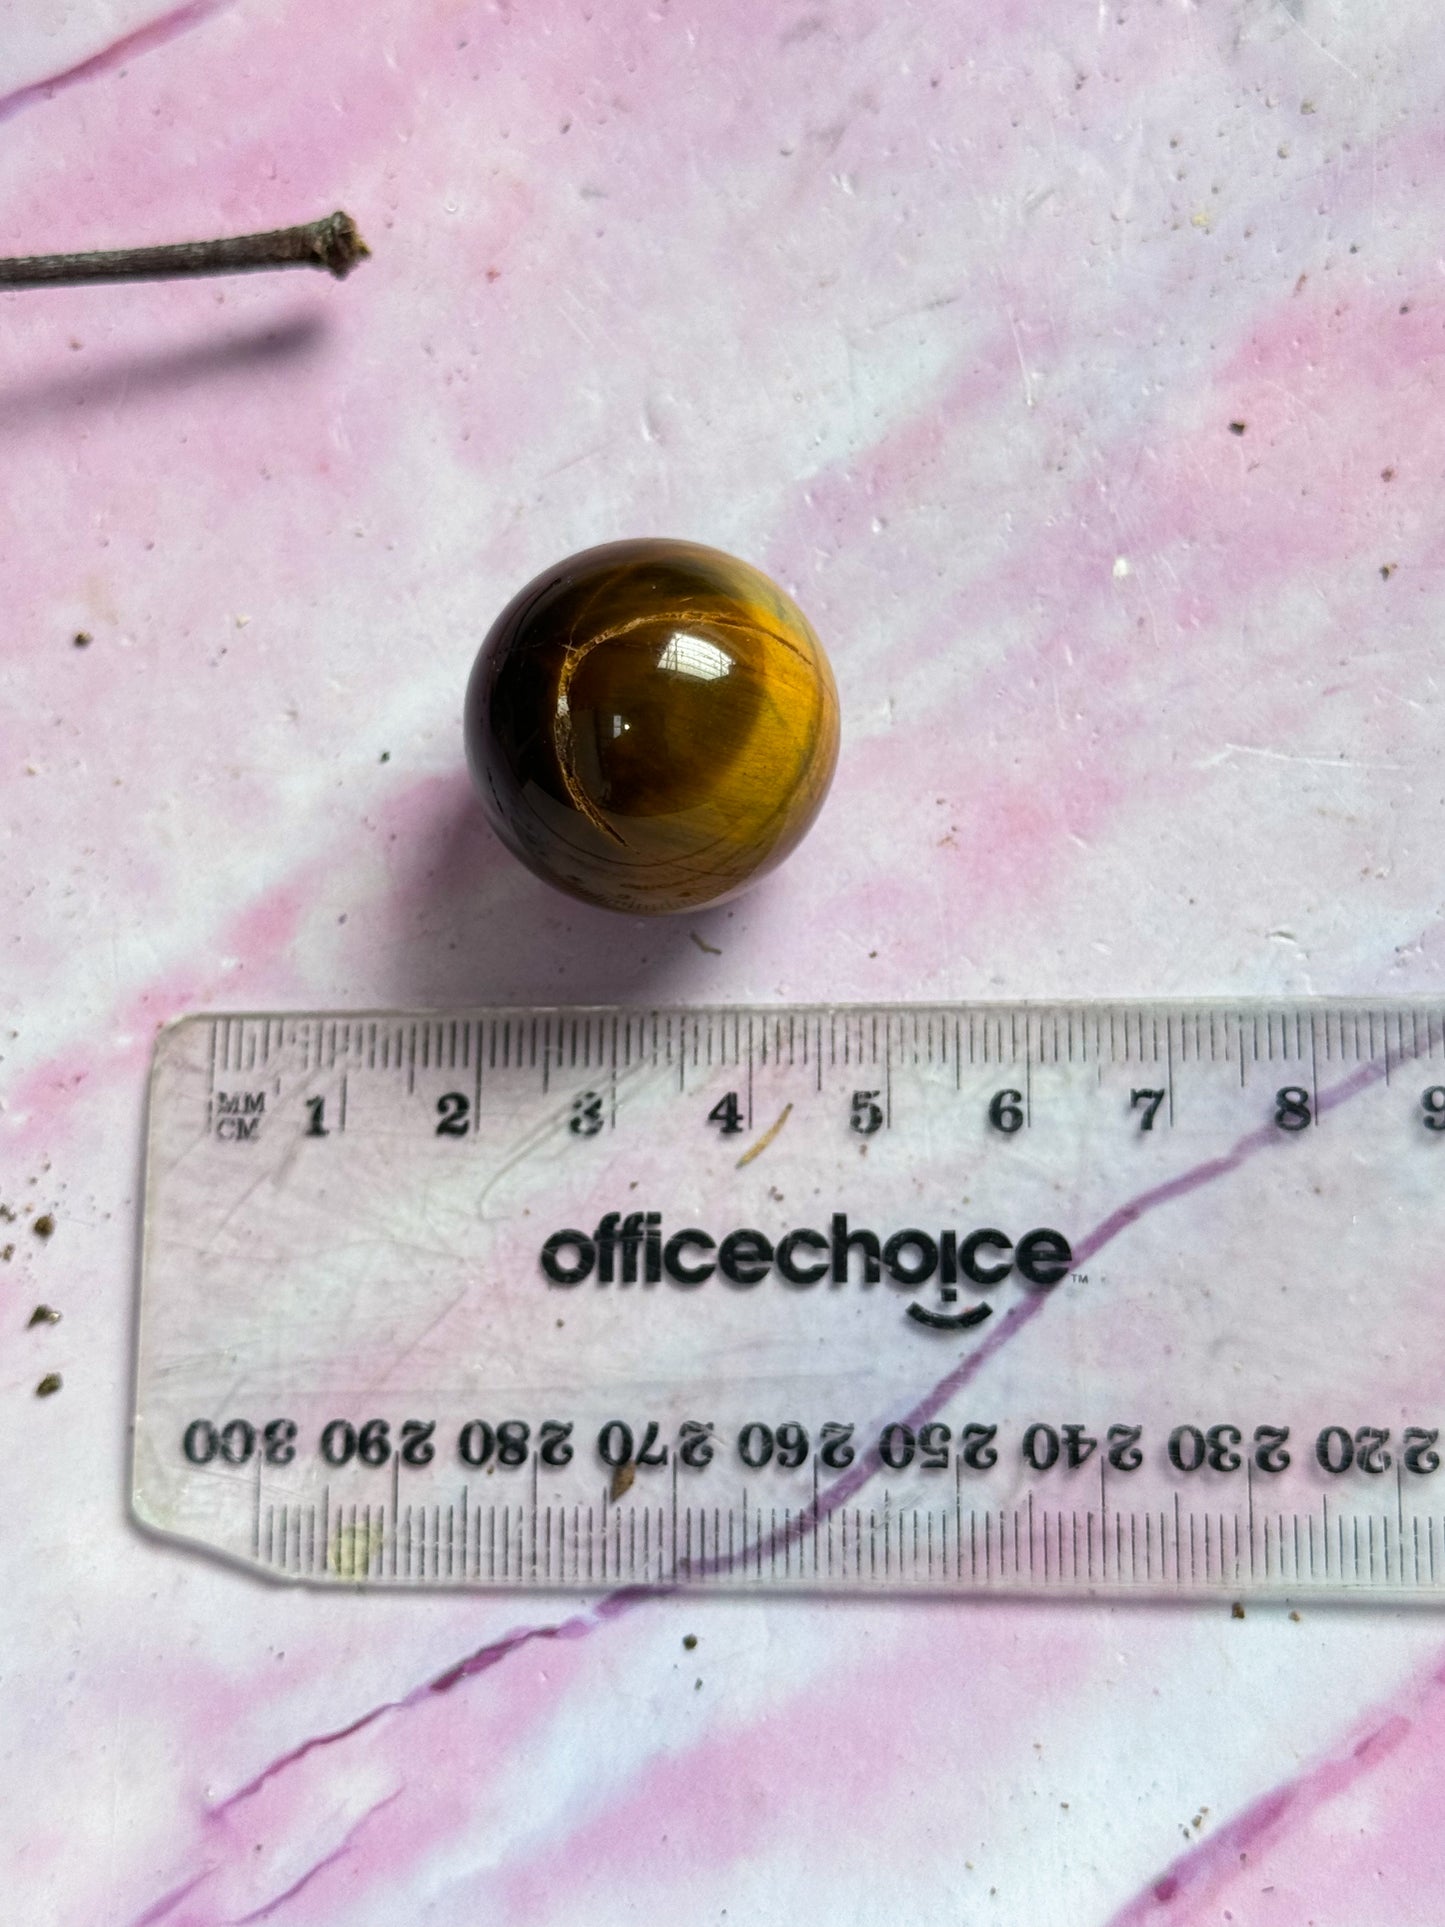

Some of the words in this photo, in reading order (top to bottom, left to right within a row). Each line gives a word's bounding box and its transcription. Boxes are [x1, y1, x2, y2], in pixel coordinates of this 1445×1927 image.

[216, 1091, 266, 1115] MM
[304, 1096, 328, 1137] 1
[435, 1092, 470, 1137] 2
[569, 1091, 604, 1137] 3
[708, 1092, 744, 1135] 4
[851, 1090, 884, 1135] 5
[988, 1088, 1024, 1134] 6
[1130, 1088, 1166, 1132] 7
[1274, 1086, 1312, 1132] 8
[1421, 1086, 1445, 1131] 9
[216, 1118, 260, 1141] CM
[541, 1211, 1072, 1302] officechoice
[183, 1418, 298, 1465] 300
[321, 1418, 436, 1466] 290
[458, 1419, 574, 1467] 280
[598, 1419, 714, 1468] 270
[739, 1420, 855, 1470] 260
[879, 1421, 998, 1471] 250
[1023, 1423, 1143, 1473] 240
[1168, 1424, 1291, 1475] 230
[1316, 1425, 1440, 1475] 220
